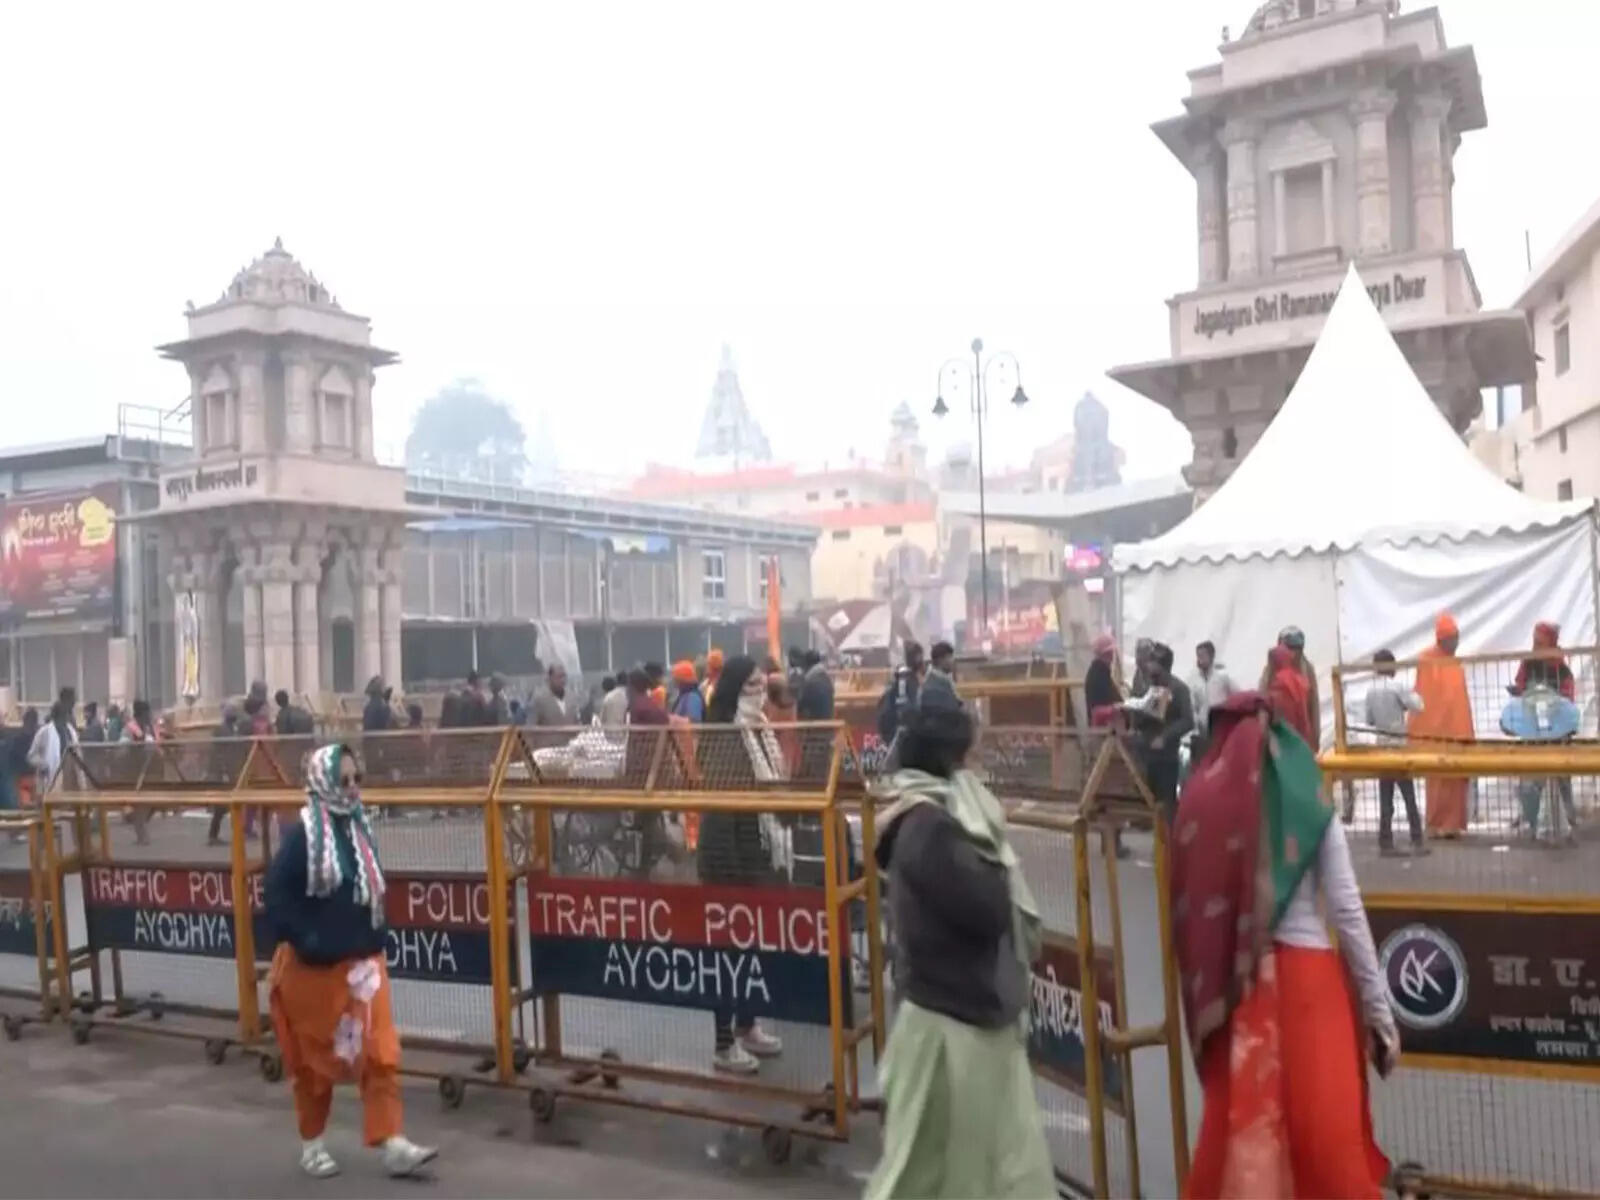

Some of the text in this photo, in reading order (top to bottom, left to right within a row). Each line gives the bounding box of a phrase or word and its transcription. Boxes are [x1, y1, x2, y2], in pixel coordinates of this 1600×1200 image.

[1254, 293, 1278, 325] Shri
[1393, 272, 1427, 304] Dwar
[89, 868, 265, 908] TRAFFIC POLE
[408, 881, 514, 925] POLIC
[134, 909, 232, 950] AYODHYA
[536, 892, 830, 957] TRAFFIC POLICE
[386, 929, 457, 973] DHYA
[603, 943, 770, 1003] AYODHYA
